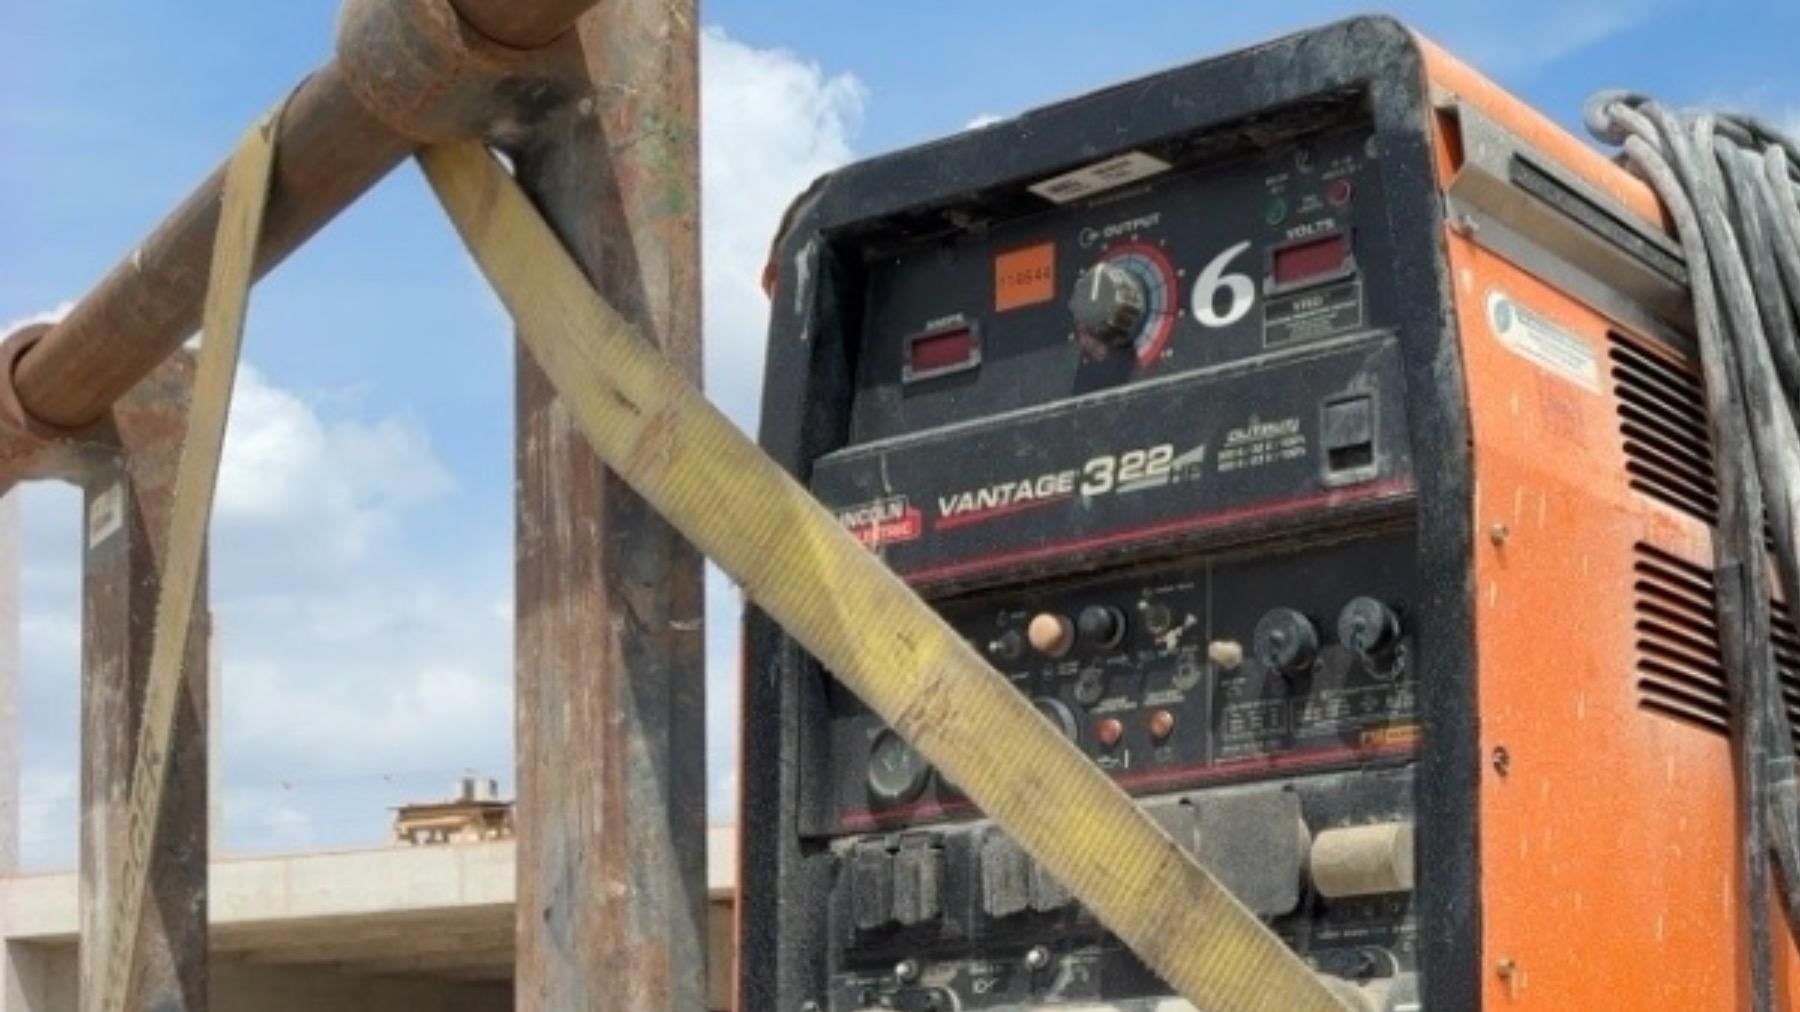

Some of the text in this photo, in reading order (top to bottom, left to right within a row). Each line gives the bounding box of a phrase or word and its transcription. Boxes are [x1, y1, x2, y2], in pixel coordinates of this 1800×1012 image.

[1190, 239, 1256, 328] 6
[937, 469, 1078, 517] VANTAGE
[1080, 442, 1175, 497] 322
